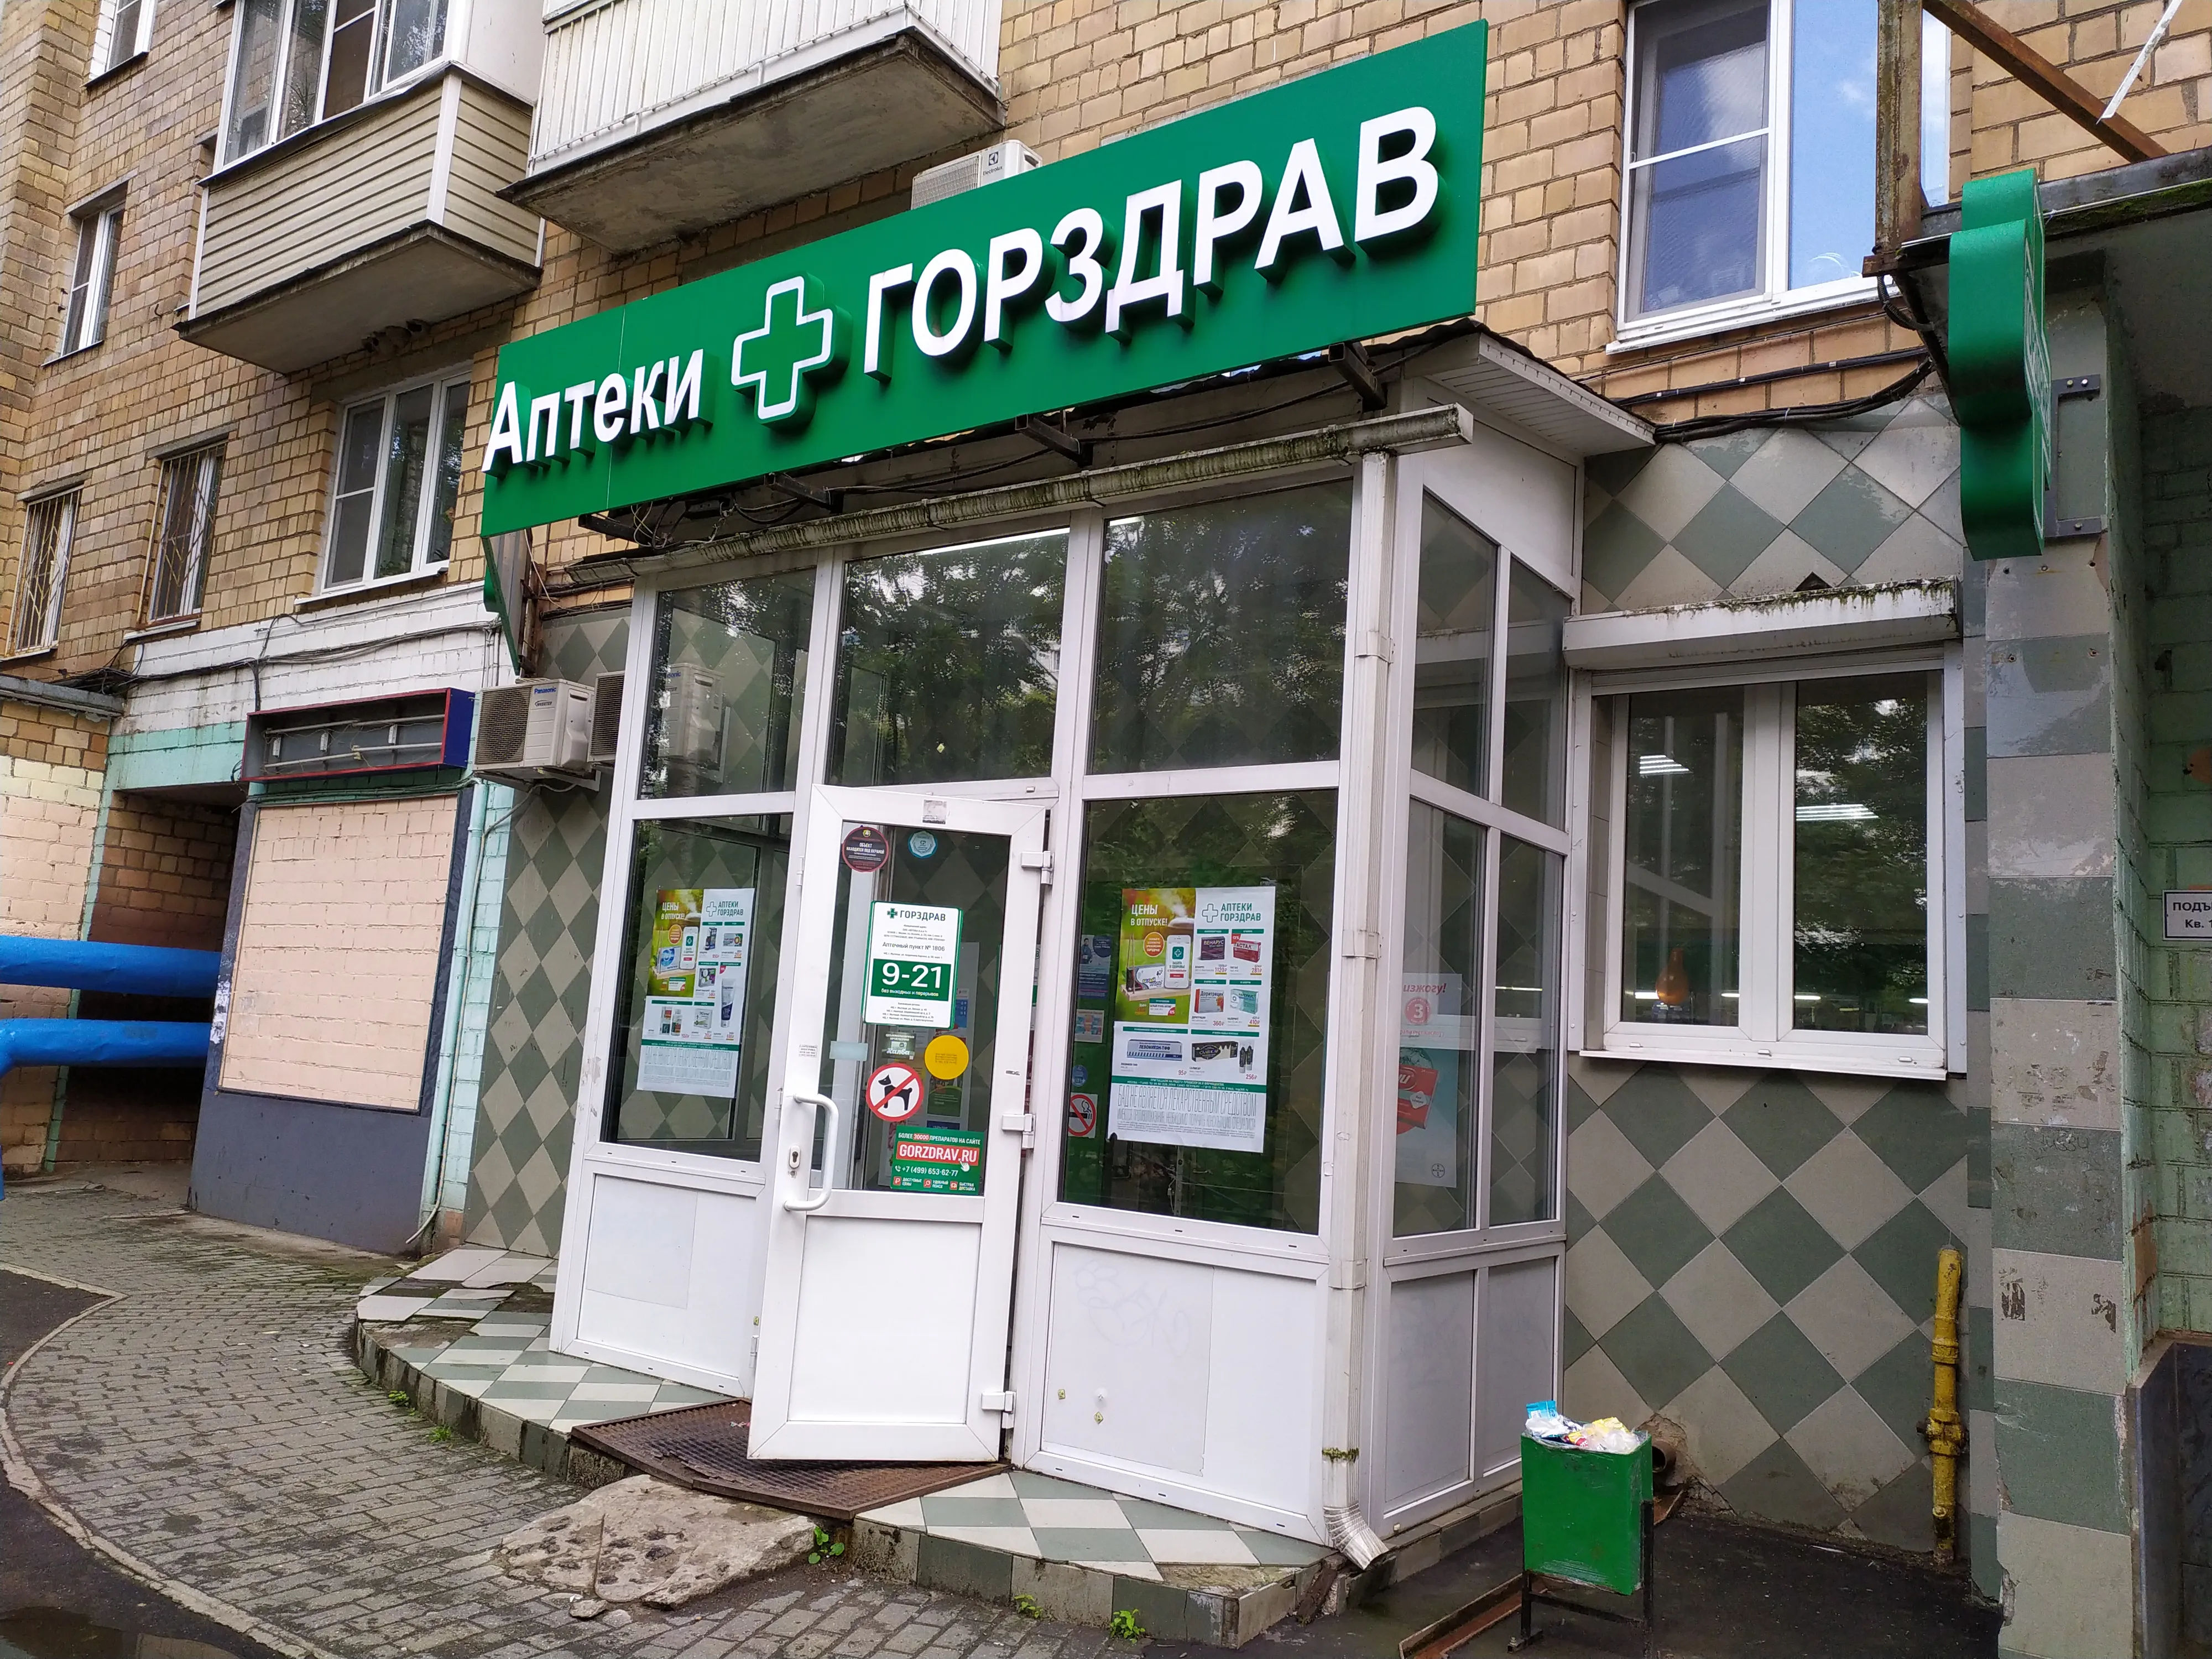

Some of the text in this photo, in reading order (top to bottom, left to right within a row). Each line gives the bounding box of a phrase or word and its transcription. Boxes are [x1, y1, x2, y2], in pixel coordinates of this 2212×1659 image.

[983, 166, 1003, 176] Electrolux
[482, 106, 1439, 473] Аптеки ГОРЗДРАВ
[662, 902, 679, 912] ЦЕНЫ
[1131, 904, 1158, 917] ЦЕНЫ
[1220, 902, 1253, 911] АПТЕКИ
[2173, 902, 2212, 912] ПОДЪ
[717, 909, 744, 917] ГОРЗДРАВ
[900, 910, 946, 922] ГОРЗДРАВ
[1220, 912, 1261, 923] ГОРЗДРАВ
[1130, 918, 1168, 926] В ОТПУСКЕ!
[2185, 919, 2204, 928] Кв.
[882, 962, 942, 989] 9-21
[1403, 982, 1447, 995] изжогу!
[1413, 1003, 1424, 1019] 3
[1118, 1084, 1129, 1108] БАД
[1130, 1086, 1138, 1108] НЕ
[899, 1144, 977, 1162] GORZDRAV.RU
[911, 1166, 927, 1174] (499)
[928, 1167, 958, 1177] 653-62-77
